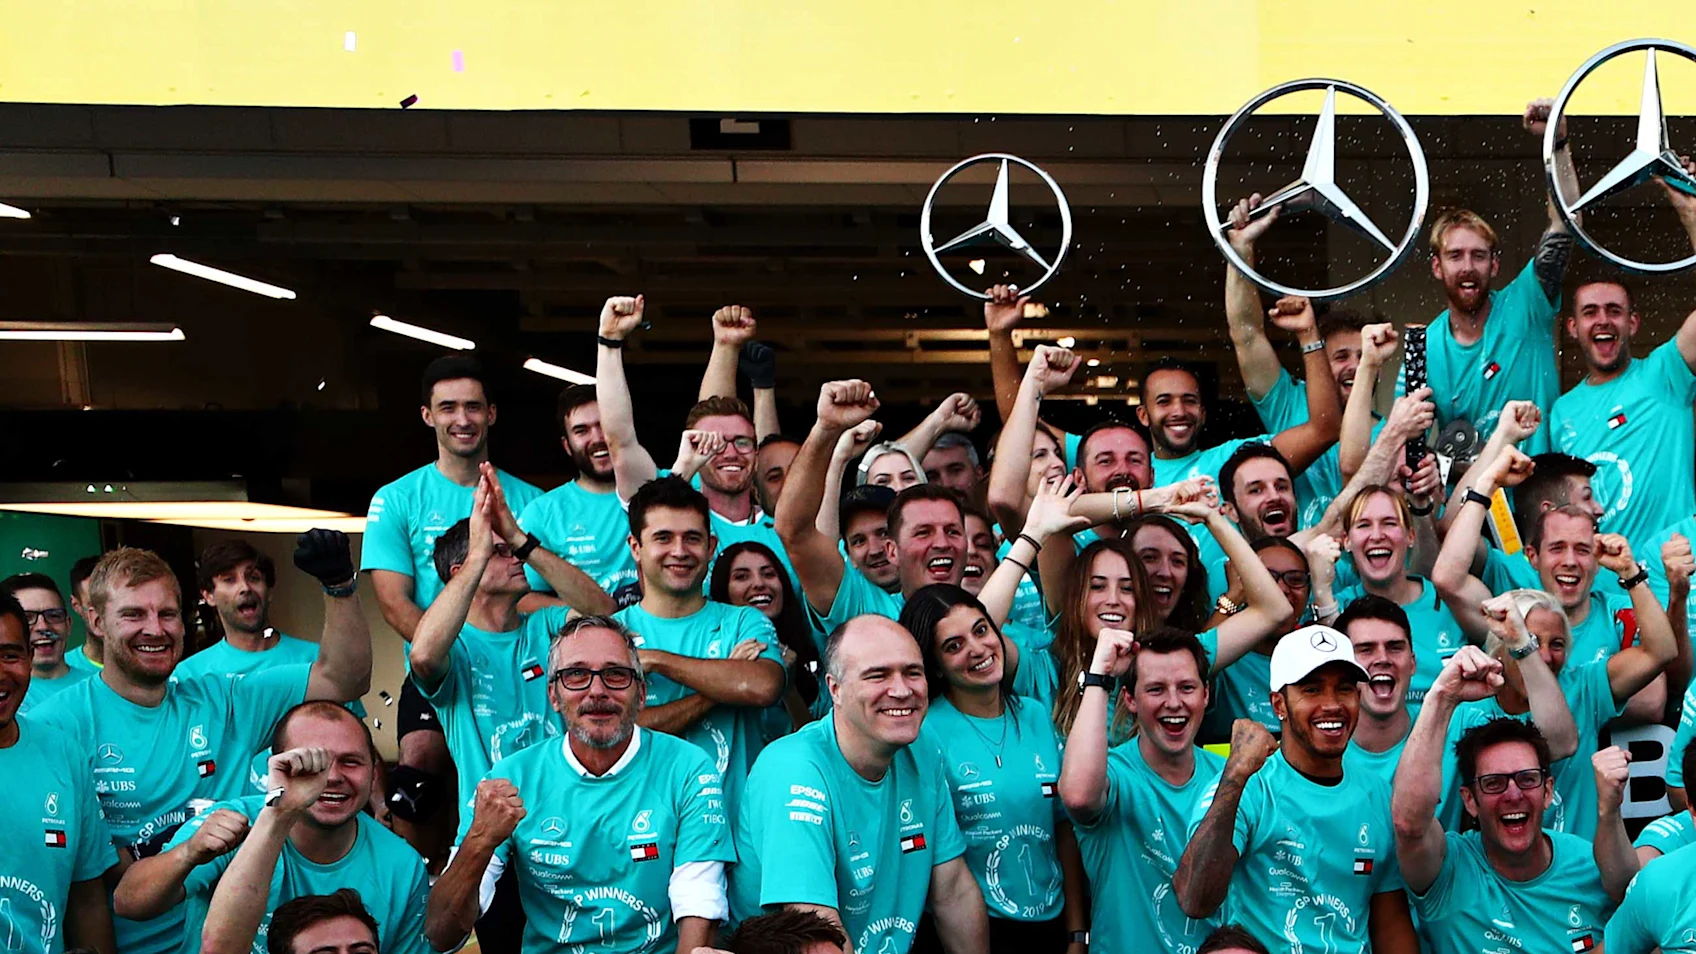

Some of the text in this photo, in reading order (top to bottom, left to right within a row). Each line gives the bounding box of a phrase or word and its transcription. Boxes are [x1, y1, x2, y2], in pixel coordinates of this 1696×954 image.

[111, 781, 136, 791] UBS
[790, 784, 825, 801] EPSON
[101, 800, 141, 808] ualcomm
[974, 793, 995, 805] UBS
[139, 812, 186, 839] GP WINN
[996, 835, 1010, 851] GP
[545, 854, 570, 865] UBS
[1269, 867, 1309, 883] Qualcomm
[0, 875, 44, 902] NNERS
[585, 886, 643, 911] WINNERS
[1295, 896, 1311, 909] GP
[1022, 903, 1045, 918] 2019
